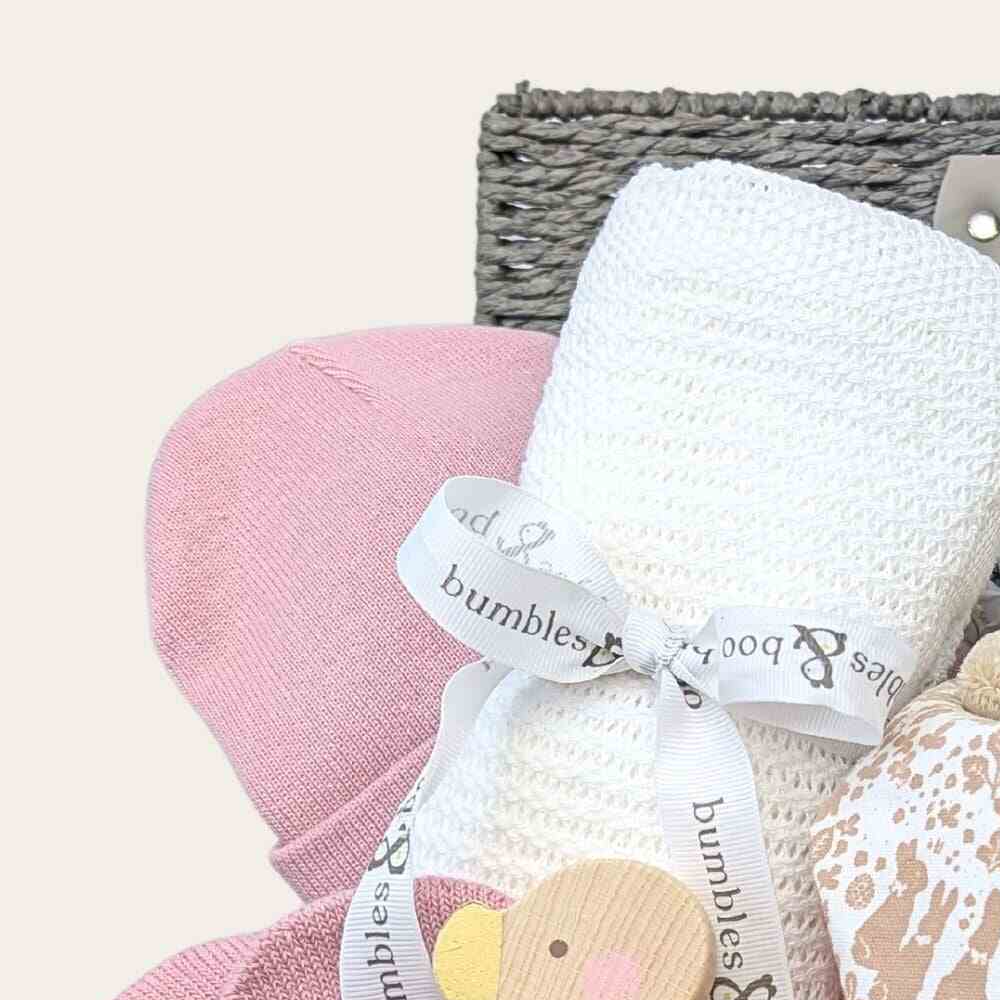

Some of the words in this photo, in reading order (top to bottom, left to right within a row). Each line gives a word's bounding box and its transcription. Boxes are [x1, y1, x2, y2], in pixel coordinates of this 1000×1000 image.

[440, 563, 588, 652] bumbles
[721, 634, 784, 666] boo
[692, 797, 748, 970] bumbles
